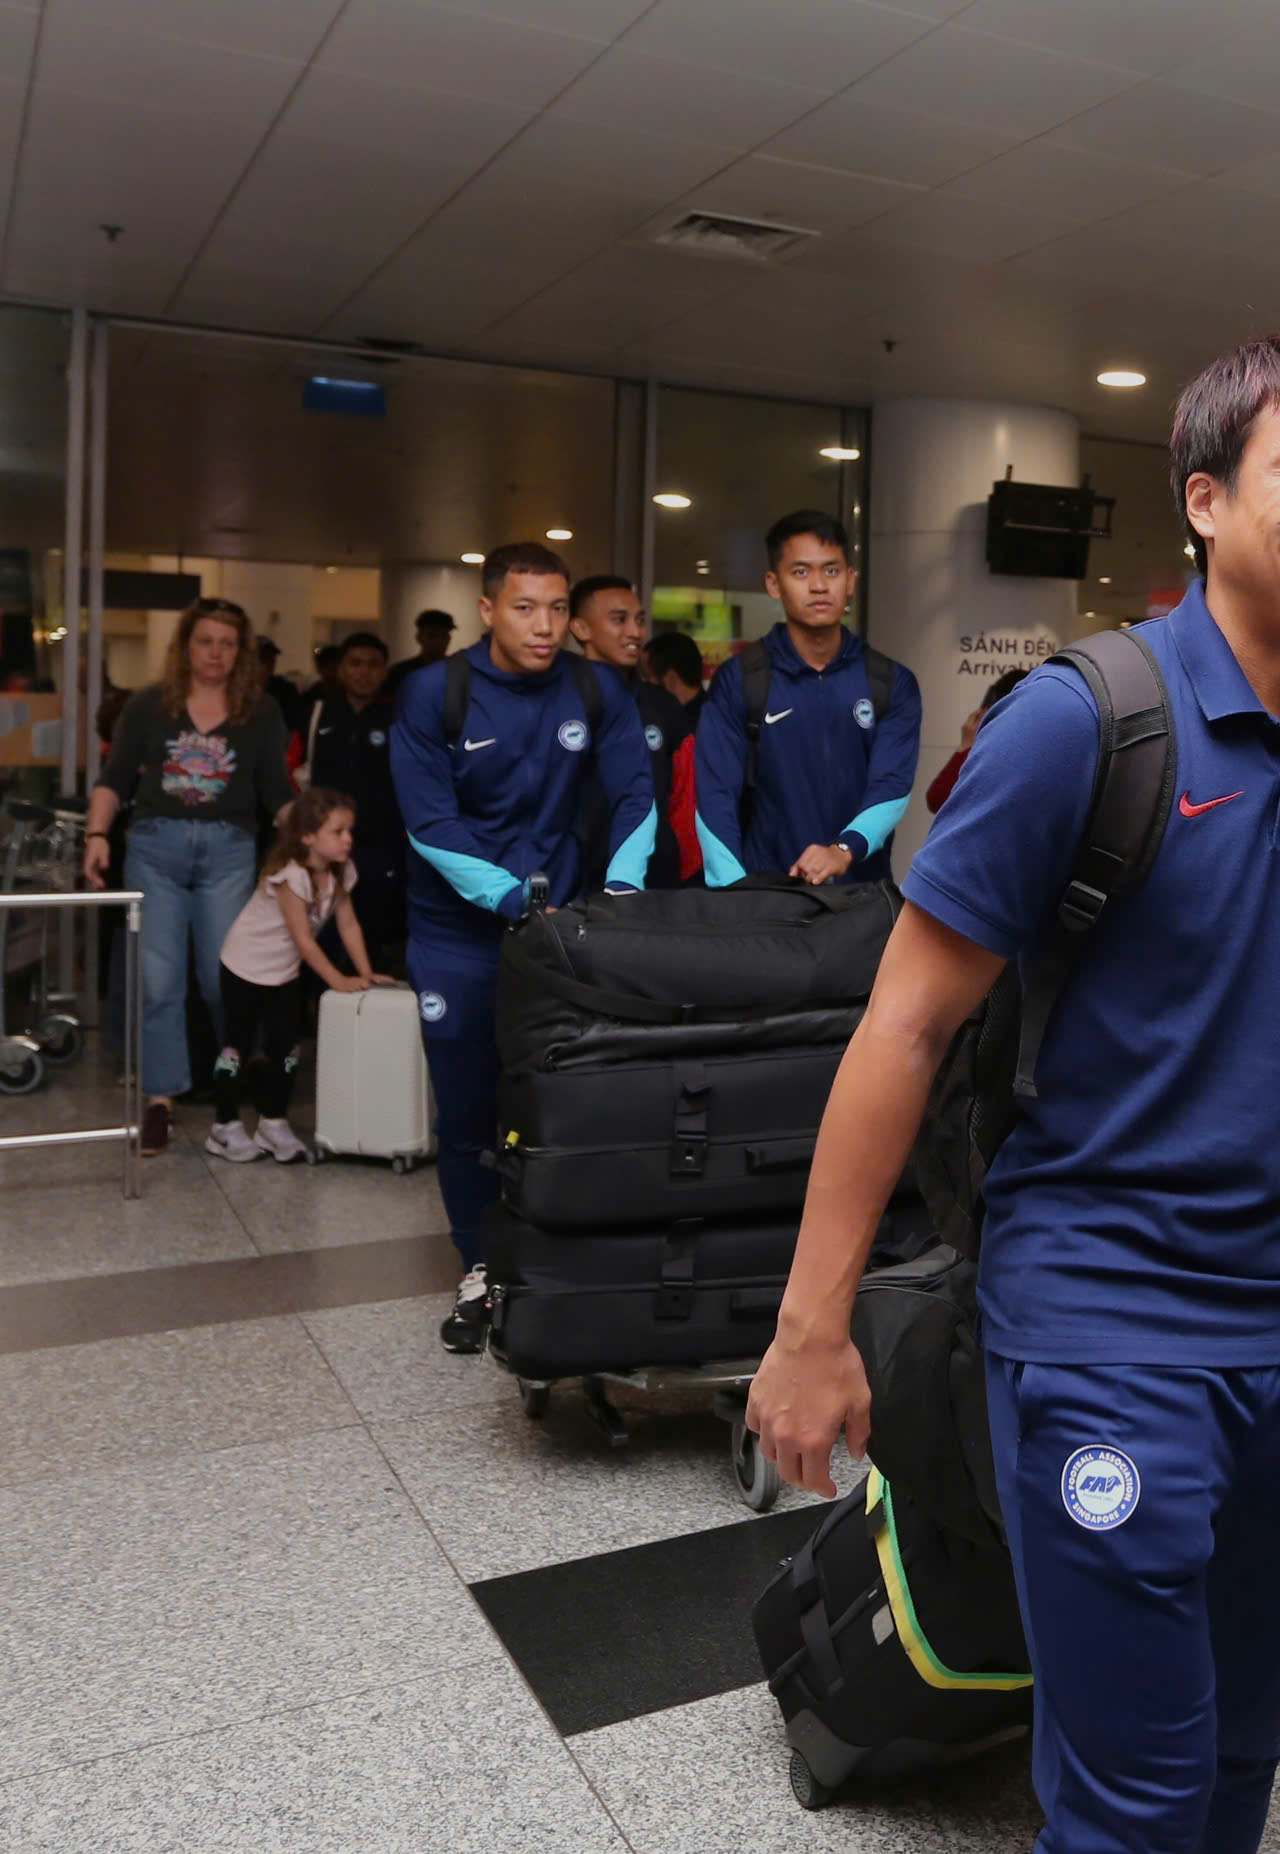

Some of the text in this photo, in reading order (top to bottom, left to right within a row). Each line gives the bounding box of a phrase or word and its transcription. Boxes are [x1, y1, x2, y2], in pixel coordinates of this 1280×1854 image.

[1068, 1451, 1134, 1503] FOOTBALL ASSOCIATION
[1072, 1502, 1121, 1525] SINGAPORE
